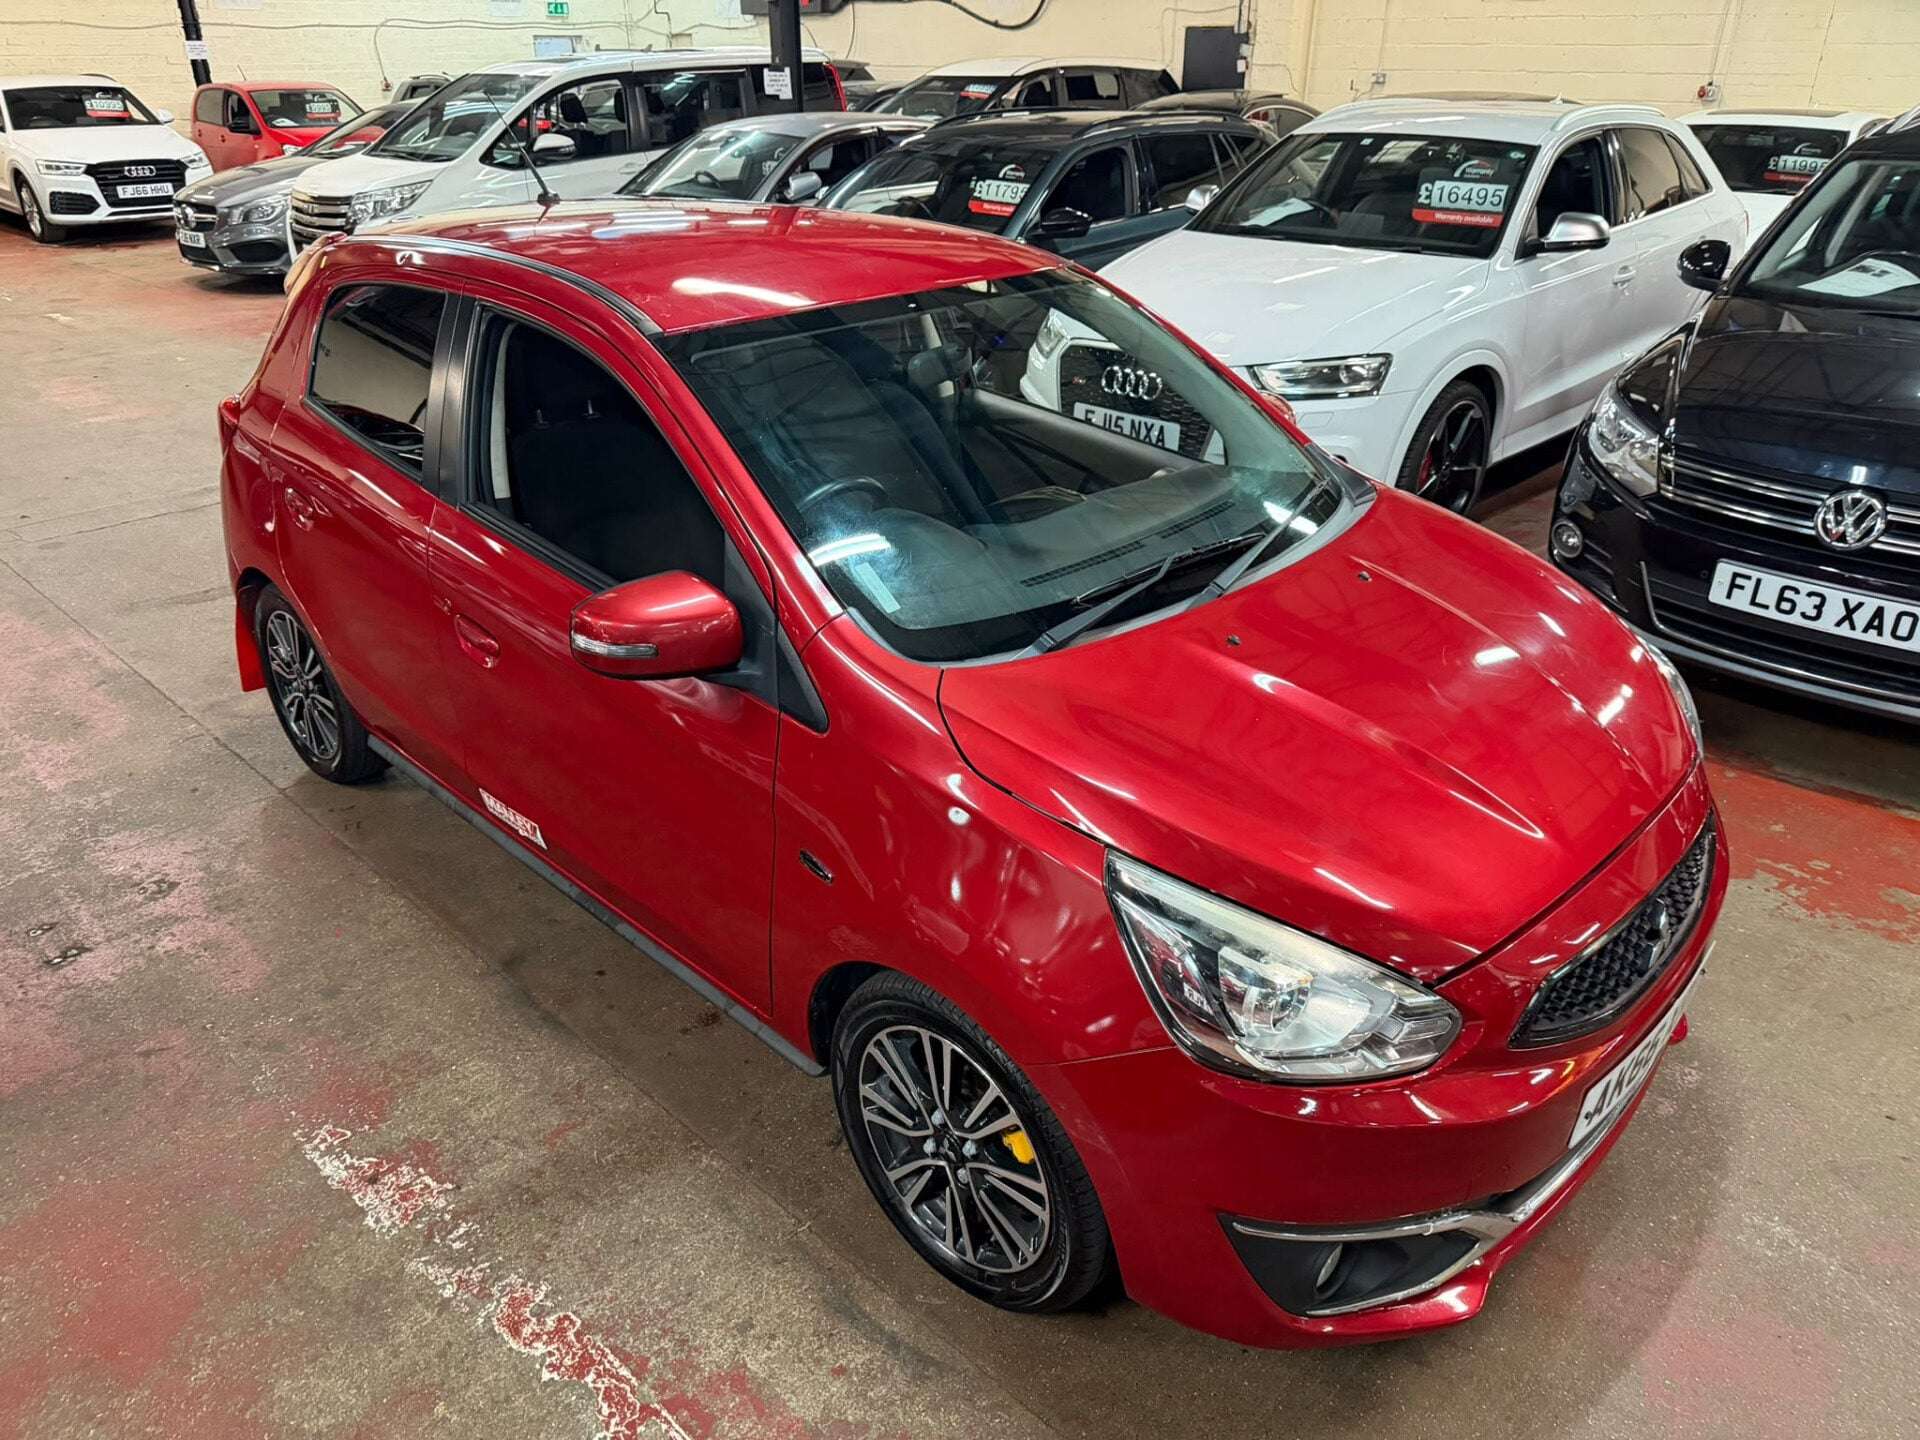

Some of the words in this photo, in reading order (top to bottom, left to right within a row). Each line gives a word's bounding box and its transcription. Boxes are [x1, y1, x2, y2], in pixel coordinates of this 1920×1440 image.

[121, 186, 149, 196] FJ66
[1418, 182, 1504, 207] £16495
[1130, 418, 1165, 447] NXA
[1725, 571, 1827, 622] FL63
[1834, 597, 1920, 642] XAO
